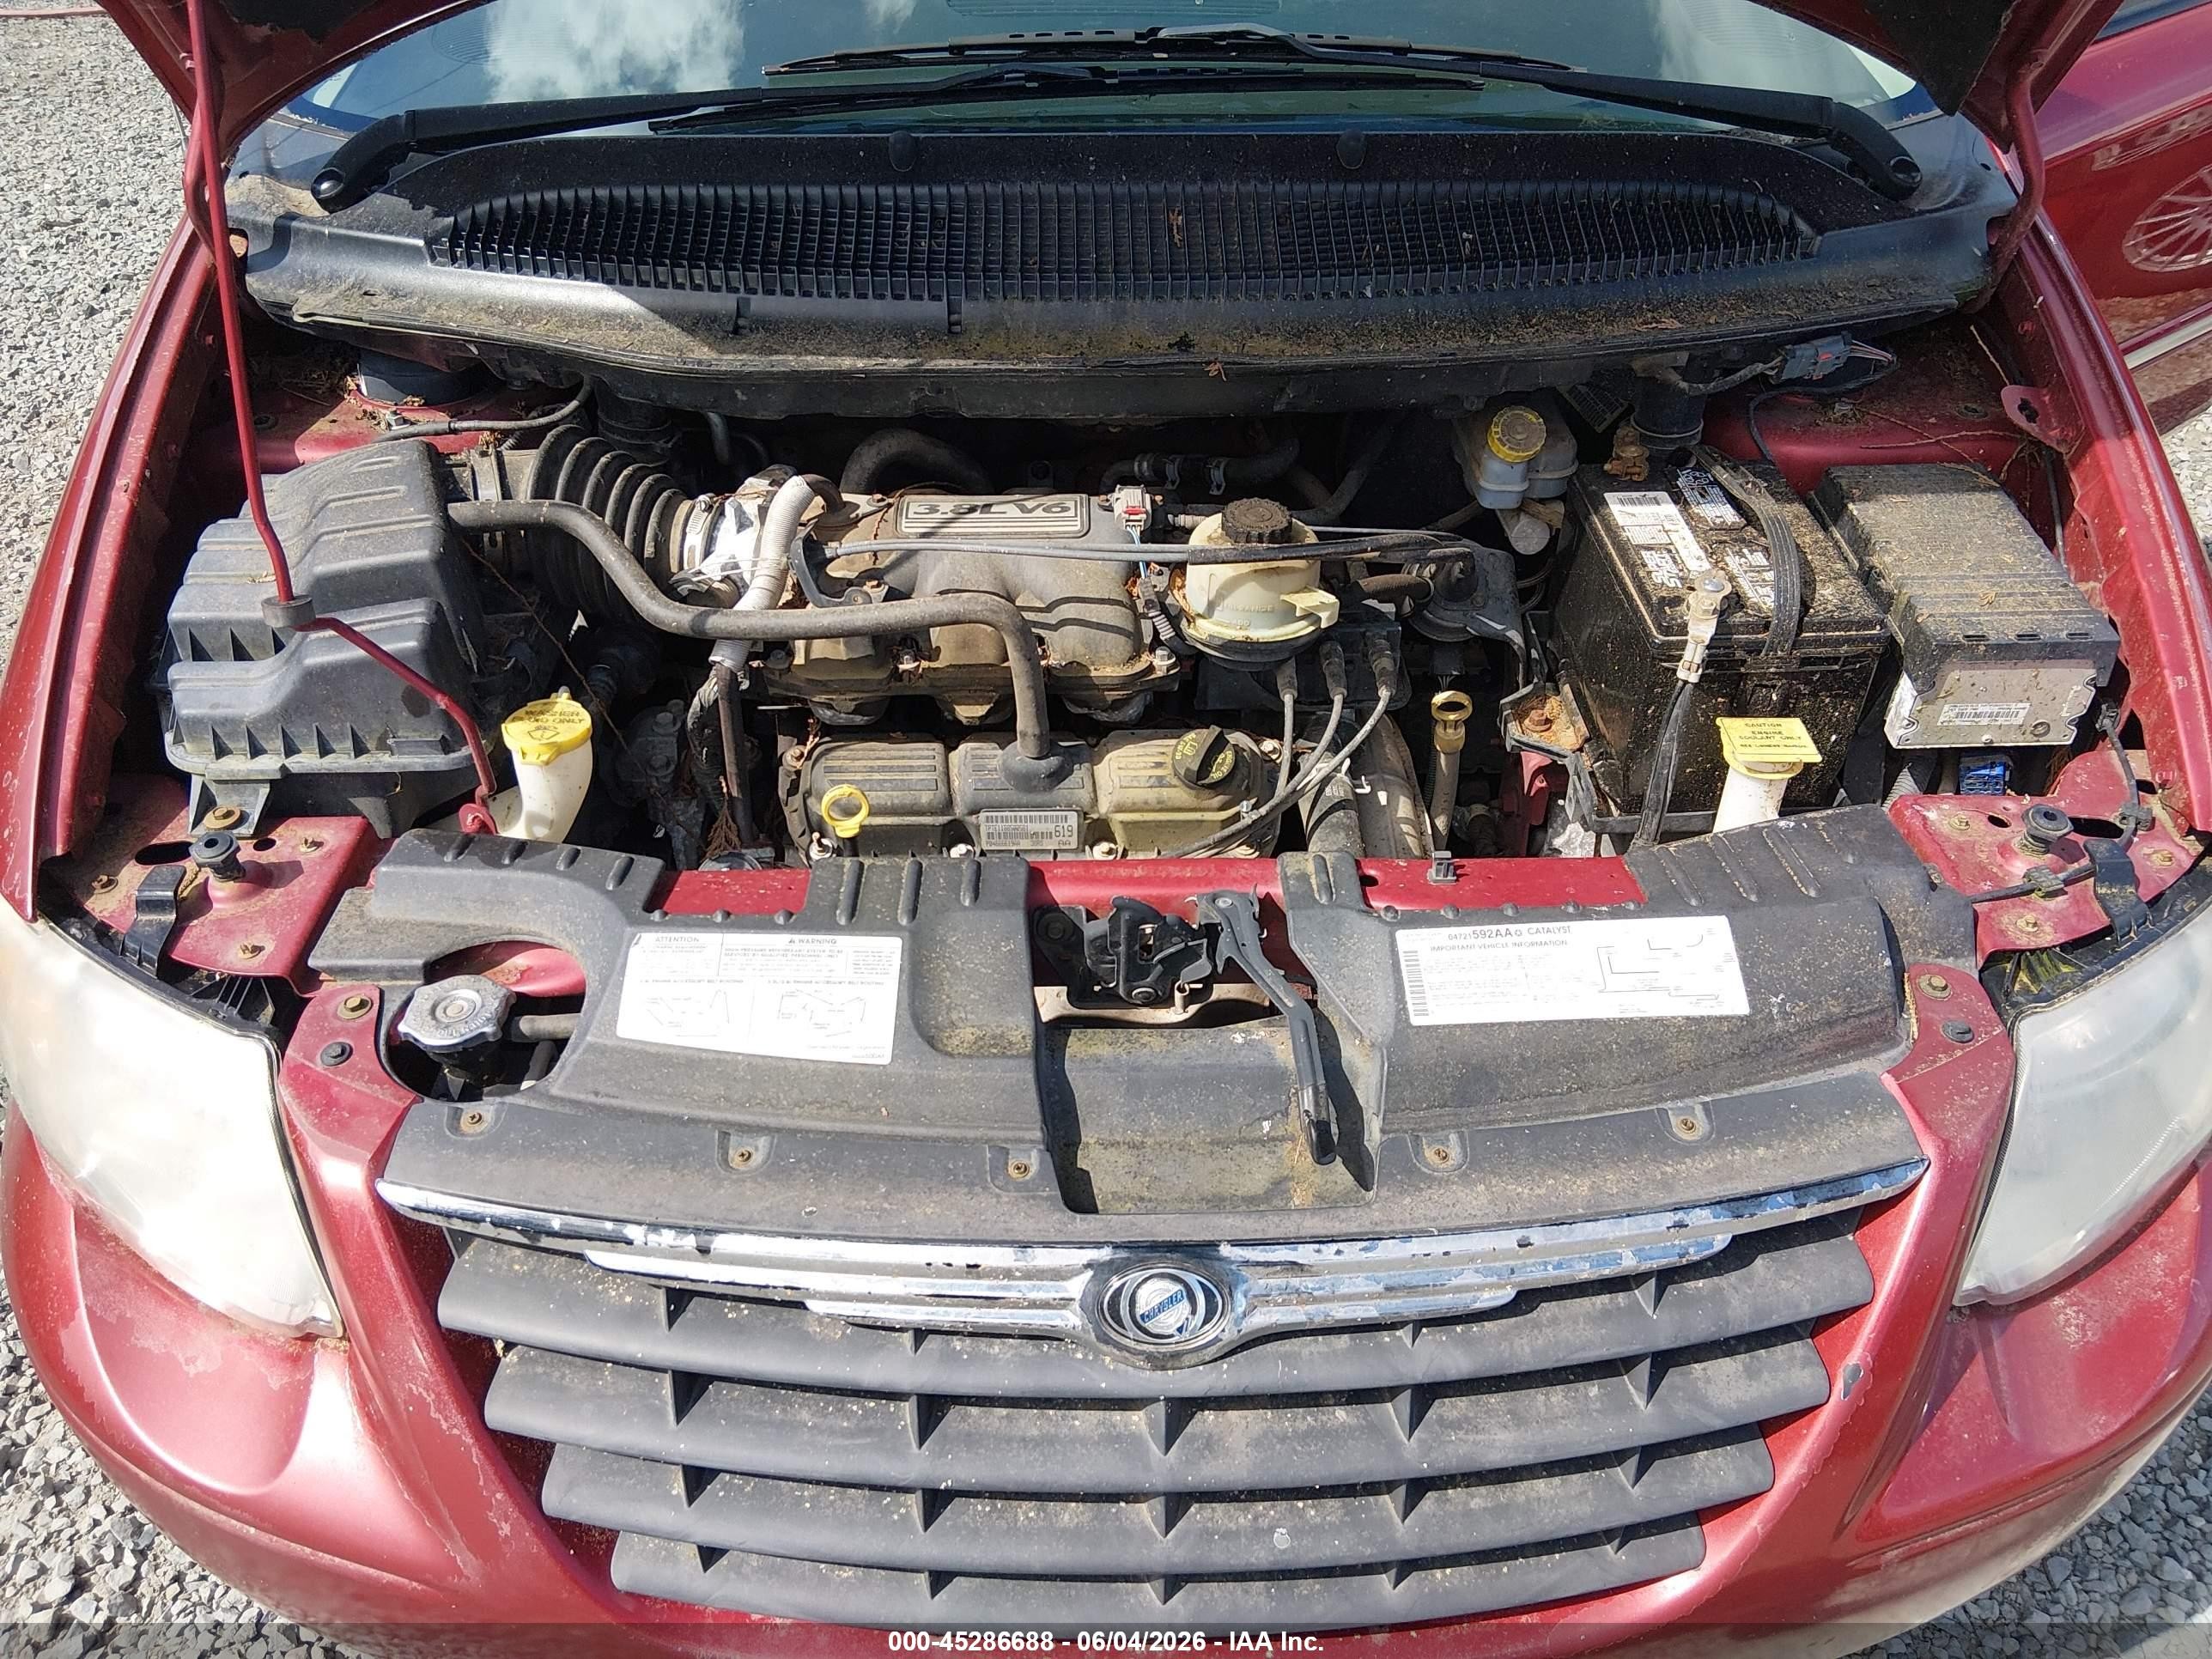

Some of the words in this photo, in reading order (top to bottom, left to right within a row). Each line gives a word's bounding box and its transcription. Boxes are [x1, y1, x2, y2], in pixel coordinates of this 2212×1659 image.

[913, 502, 1007, 515] 3.8L
[1014, 501, 1072, 514] V6
[1210, 770, 1223, 780] OIL
[1054, 824, 1073, 838] 619
[1448, 927, 1514, 940] 04721592AA
[1527, 926, 1571, 935] CATALYST
[1430, 944, 1475, 952] IMPORTANT
[1511, 939, 1568, 948] INFORMATION
[1144, 1289, 1183, 1321] CHRYSLER
